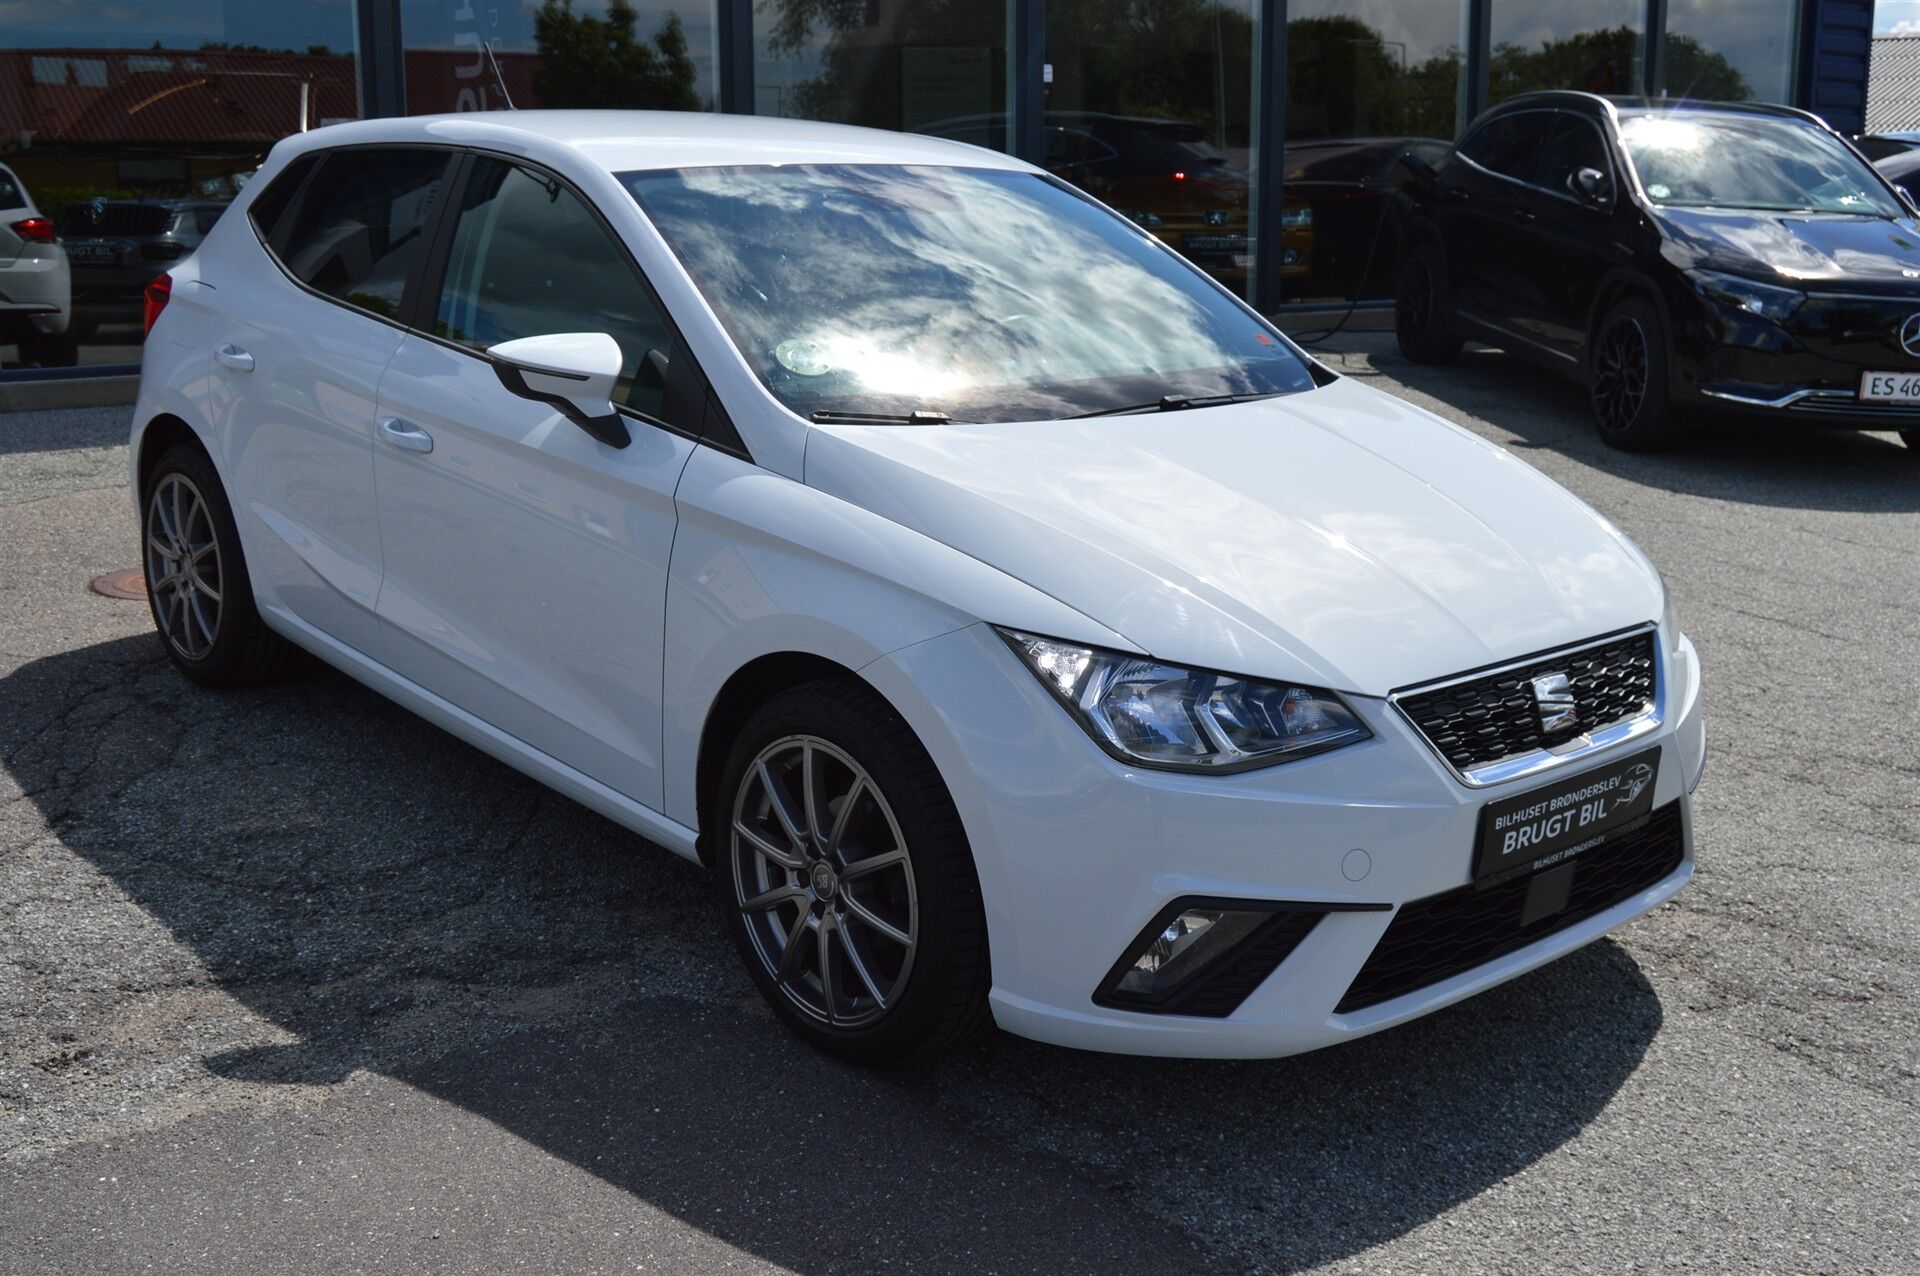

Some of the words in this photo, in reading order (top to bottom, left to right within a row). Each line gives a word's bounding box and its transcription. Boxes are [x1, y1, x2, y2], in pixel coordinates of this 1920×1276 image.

[1871, 377, 1895, 396] ES
[1900, 377, 1920, 397] 46
[1495, 801, 1549, 830] BILHUSET
[1549, 775, 1622, 811] BRØNDERSLEV
[1502, 809, 1576, 855] BRUGT
[1579, 798, 1607, 827] BIL
[1533, 851, 1563, 870] BILHUSET
